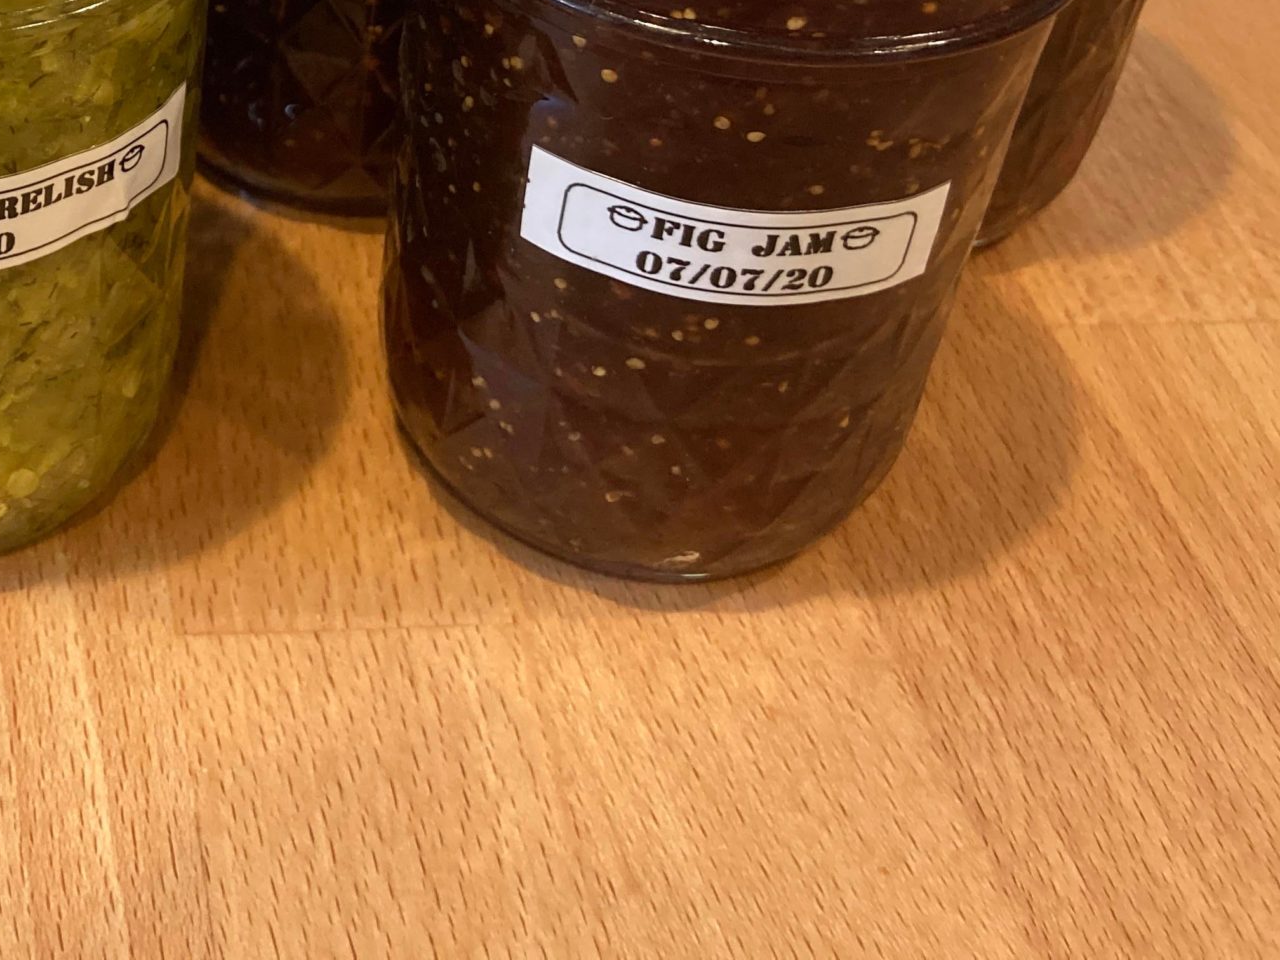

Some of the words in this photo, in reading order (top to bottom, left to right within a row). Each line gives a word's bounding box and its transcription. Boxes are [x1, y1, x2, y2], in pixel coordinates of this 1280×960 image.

[650, 215, 727, 254] FIG
[750, 229, 837, 258] JAM
[635, 249, 834, 292] 07/07/20
